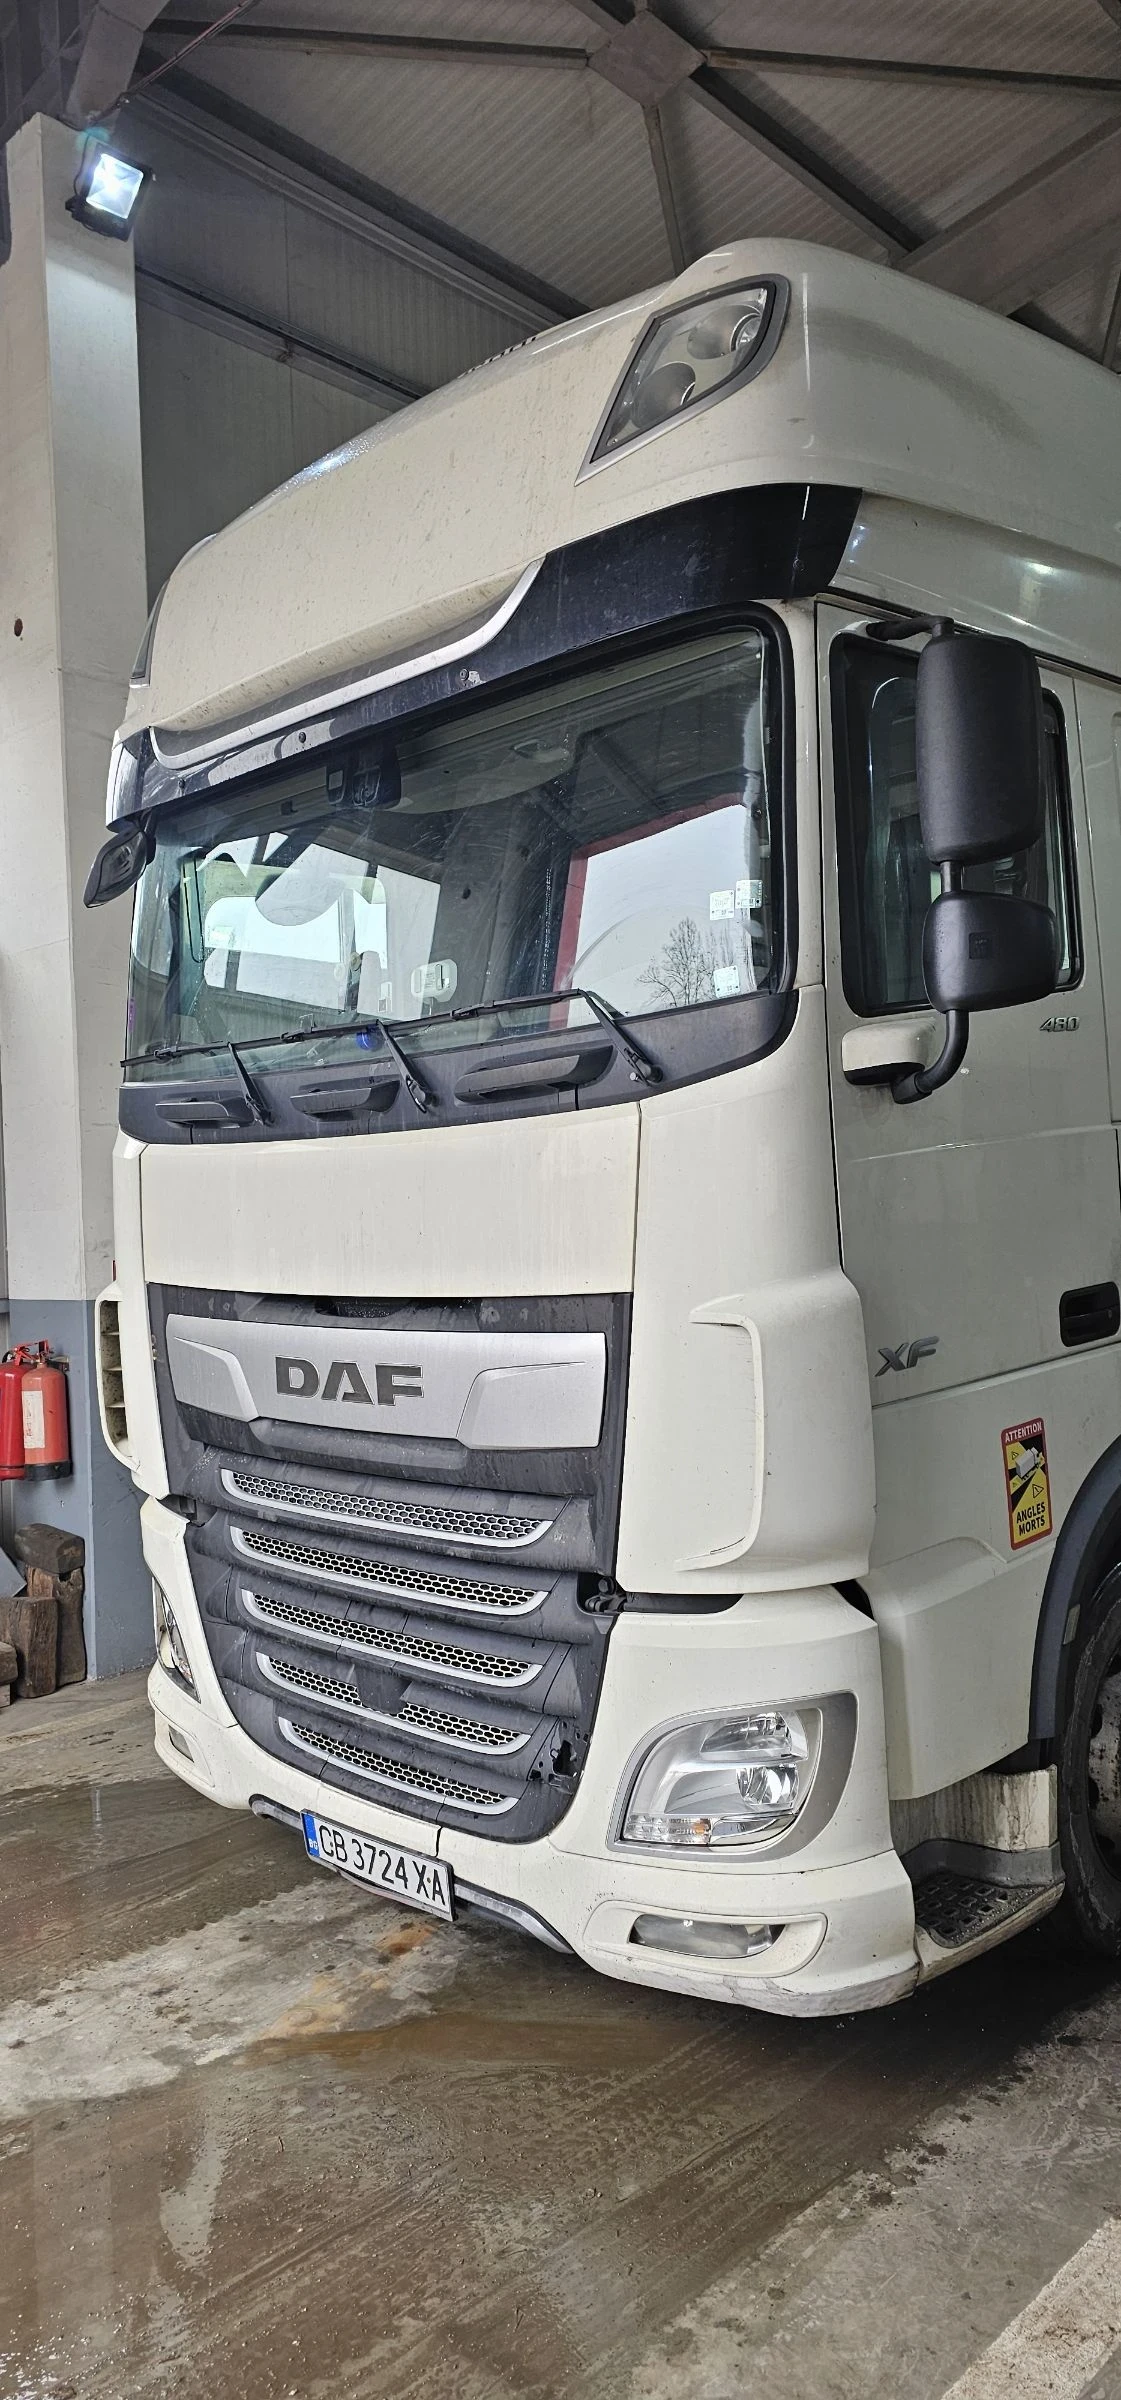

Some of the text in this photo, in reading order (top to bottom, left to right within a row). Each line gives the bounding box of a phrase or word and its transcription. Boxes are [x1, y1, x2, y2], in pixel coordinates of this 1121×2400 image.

[1039, 1016, 1080, 1033] 480
[874, 1335, 940, 1378] XF
[275, 1355, 424, 1406] DAF
[1004, 1421, 1043, 1443] ATTENTION
[1016, 1501, 1046, 1524] ANGLES
[1018, 1514, 1046, 1537] MORTS
[318, 1824, 446, 1906] CB 3724 XA
